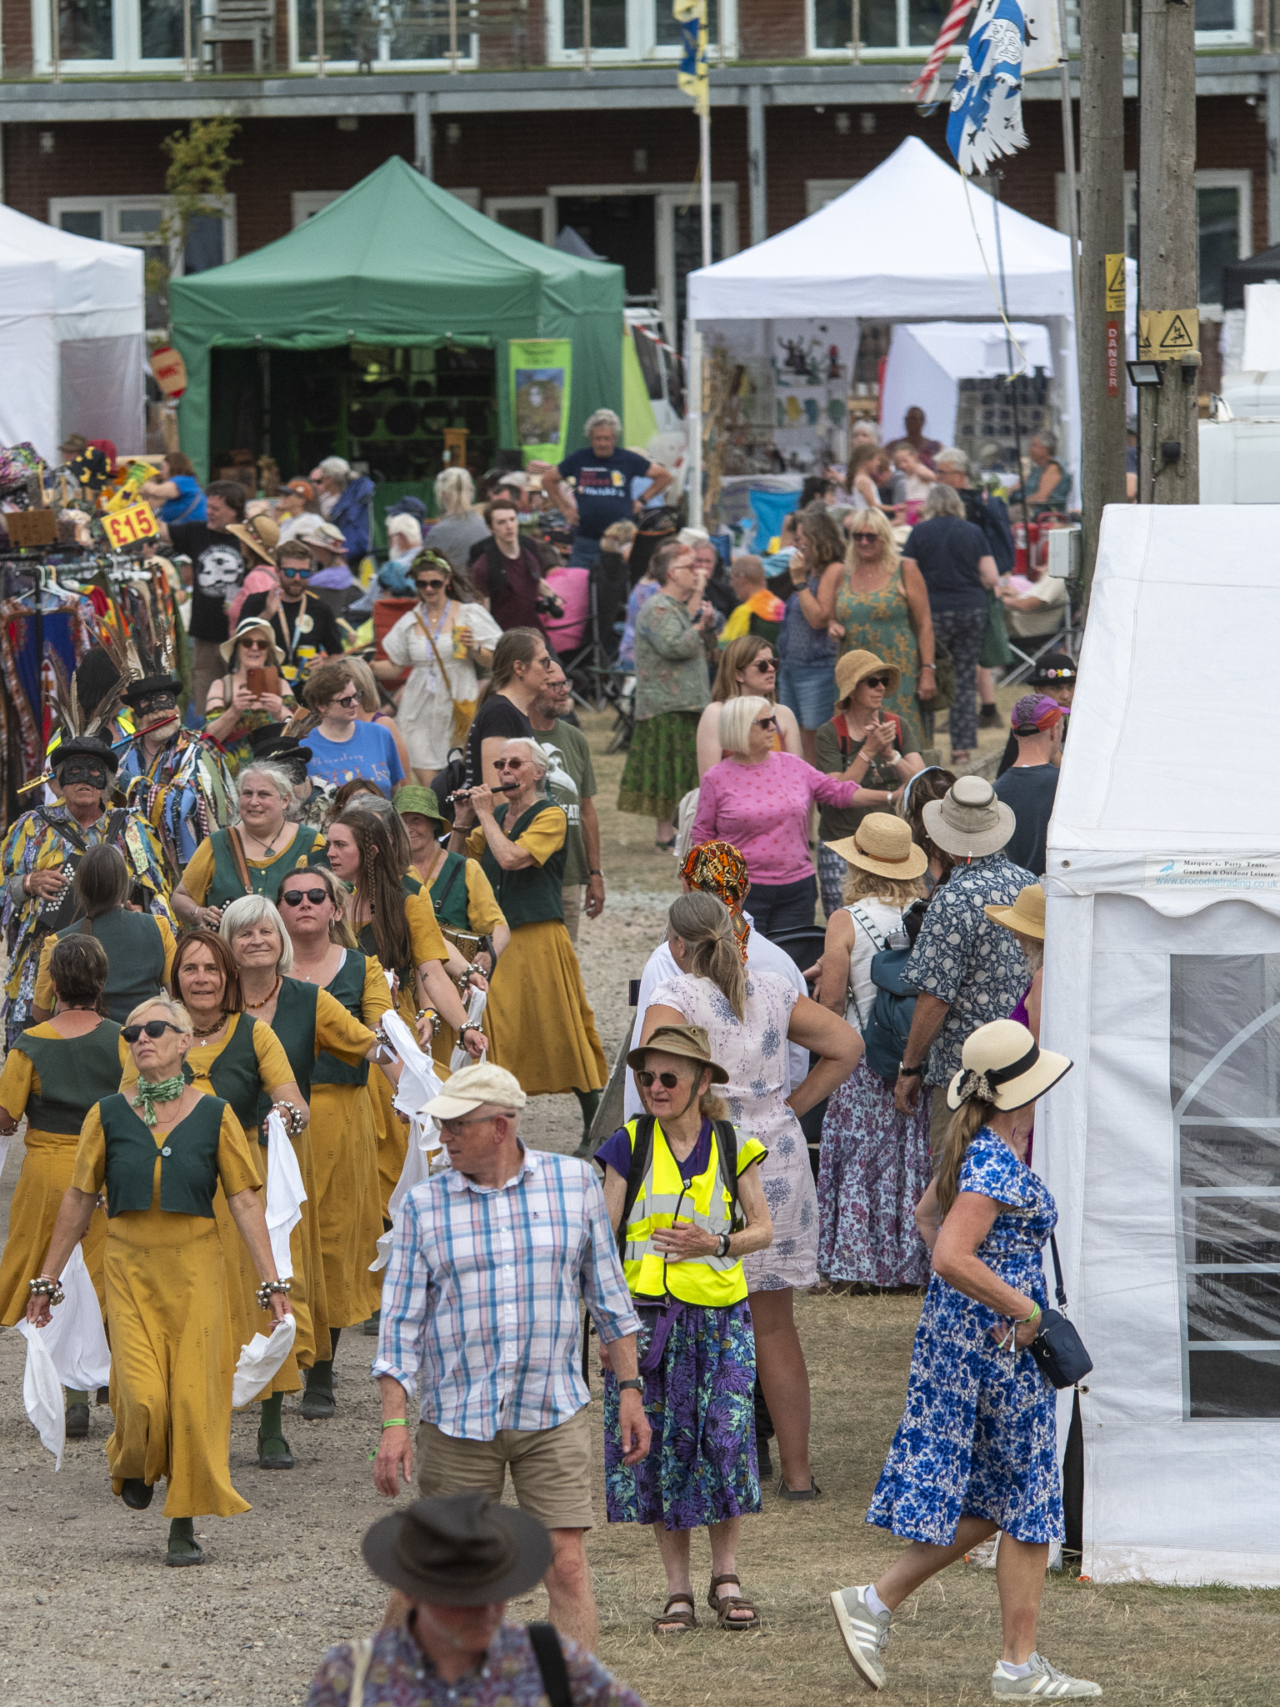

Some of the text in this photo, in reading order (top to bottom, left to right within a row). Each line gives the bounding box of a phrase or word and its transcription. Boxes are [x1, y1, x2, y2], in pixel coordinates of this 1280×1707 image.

[1108, 329, 1117, 387] DANGER
[110, 509, 152, 543] £15
[1224, 861, 1242, 869] Party
[1155, 876, 1278, 889] www.crocodiletrading.co.uk
